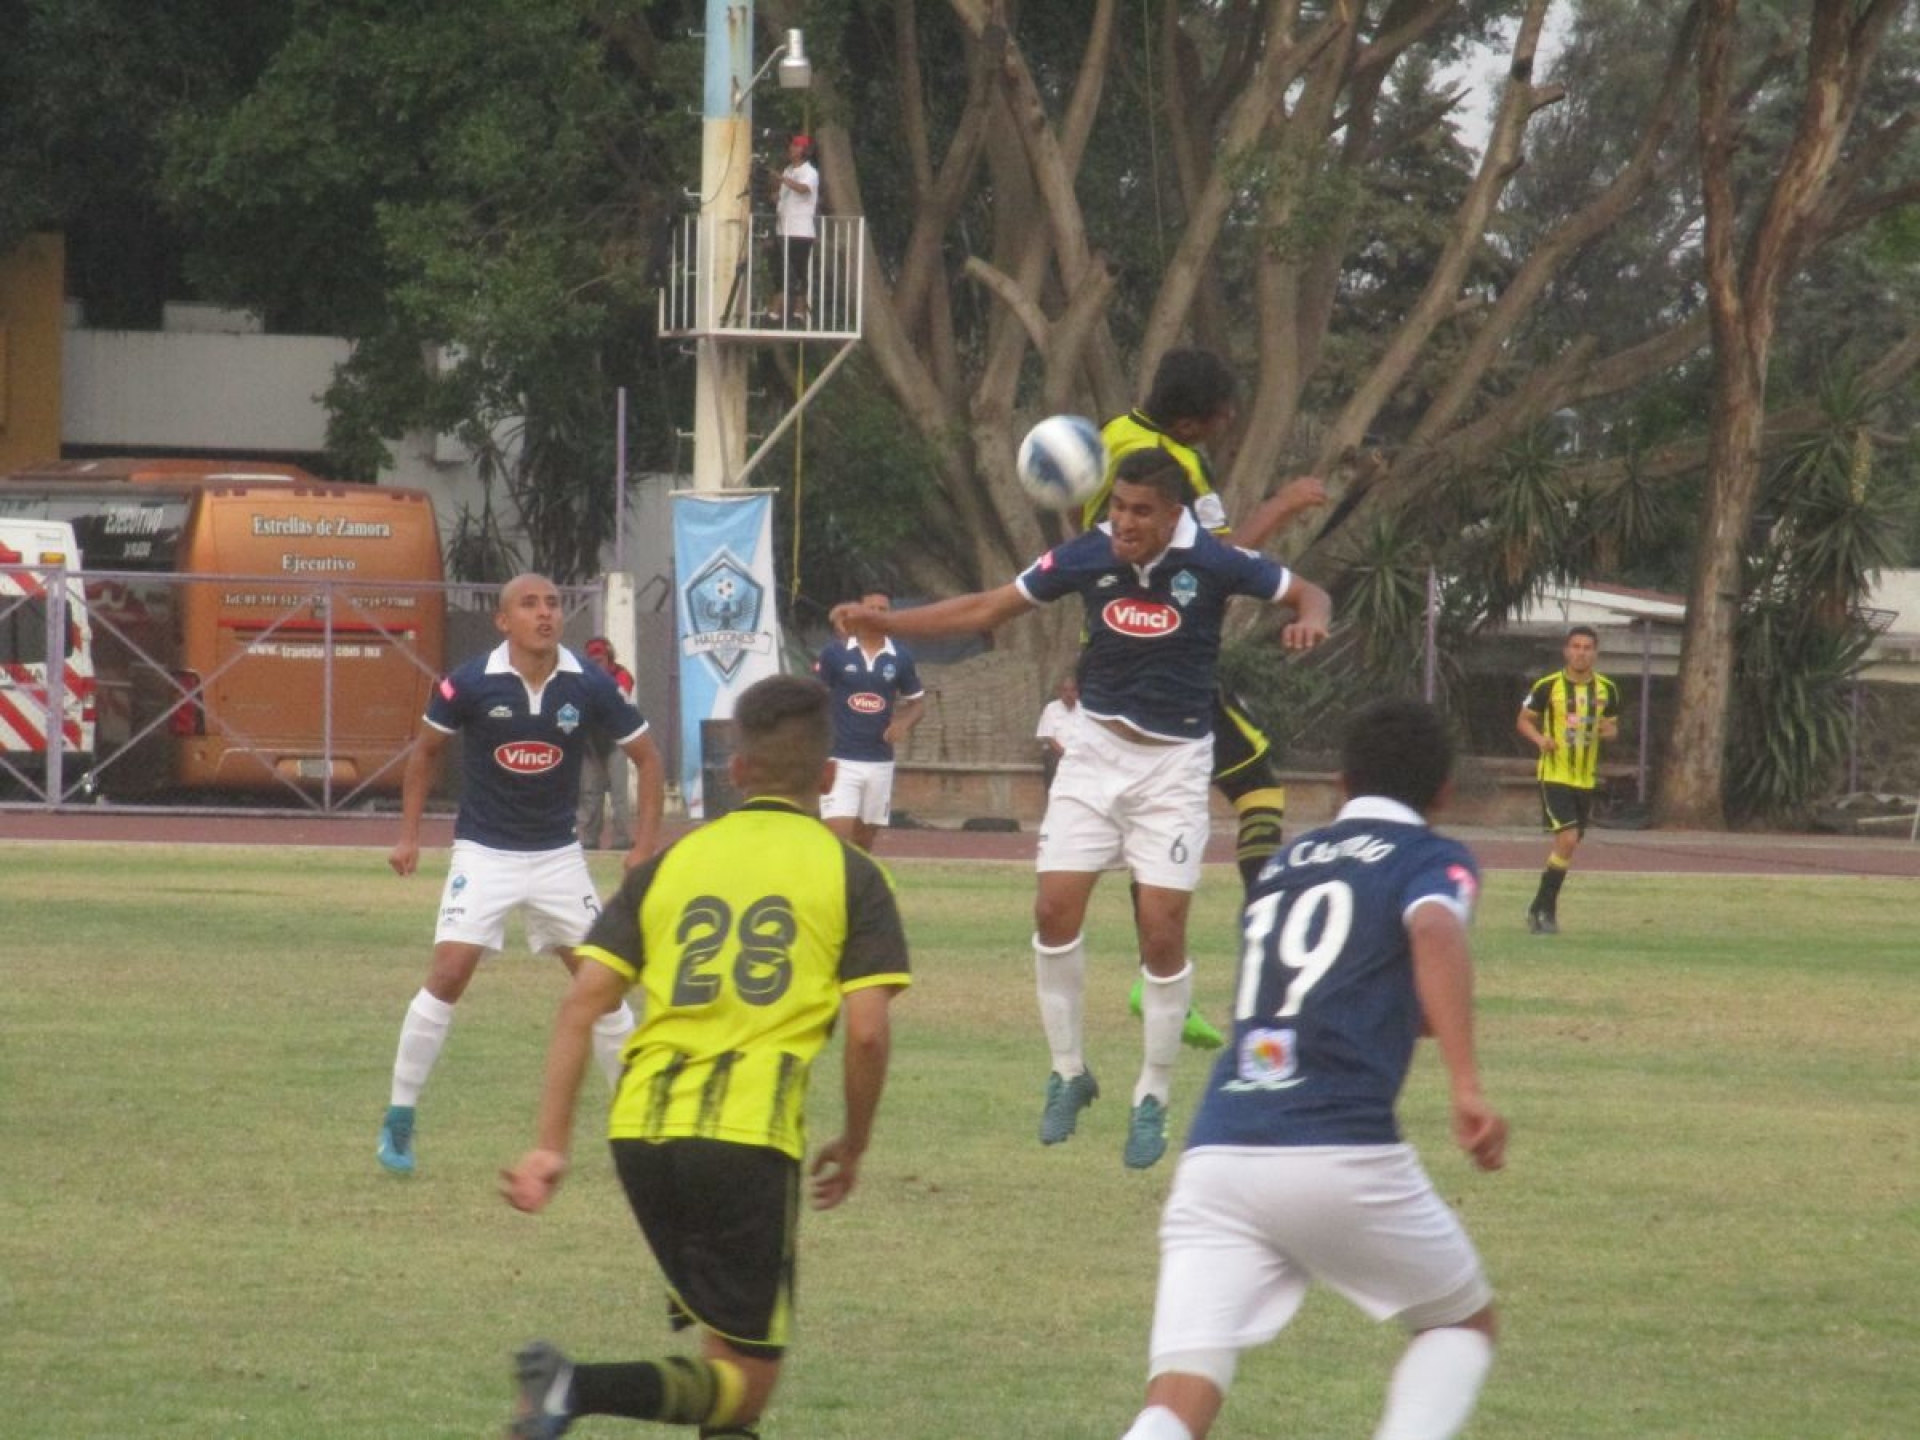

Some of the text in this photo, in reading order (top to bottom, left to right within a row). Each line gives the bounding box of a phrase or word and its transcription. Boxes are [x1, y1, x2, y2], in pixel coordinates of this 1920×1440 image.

[253, 515, 391, 537] Estrellas de Zamora
[282, 554, 356, 573] Ejecutivo
[1113, 605, 1169, 629] Vinci
[853, 698, 879, 709] Vinci
[503, 749, 553, 766] Vinci
[1170, 833, 1188, 864] 6
[671, 894, 798, 1007] 28
[1235, 879, 1353, 1020] 19
